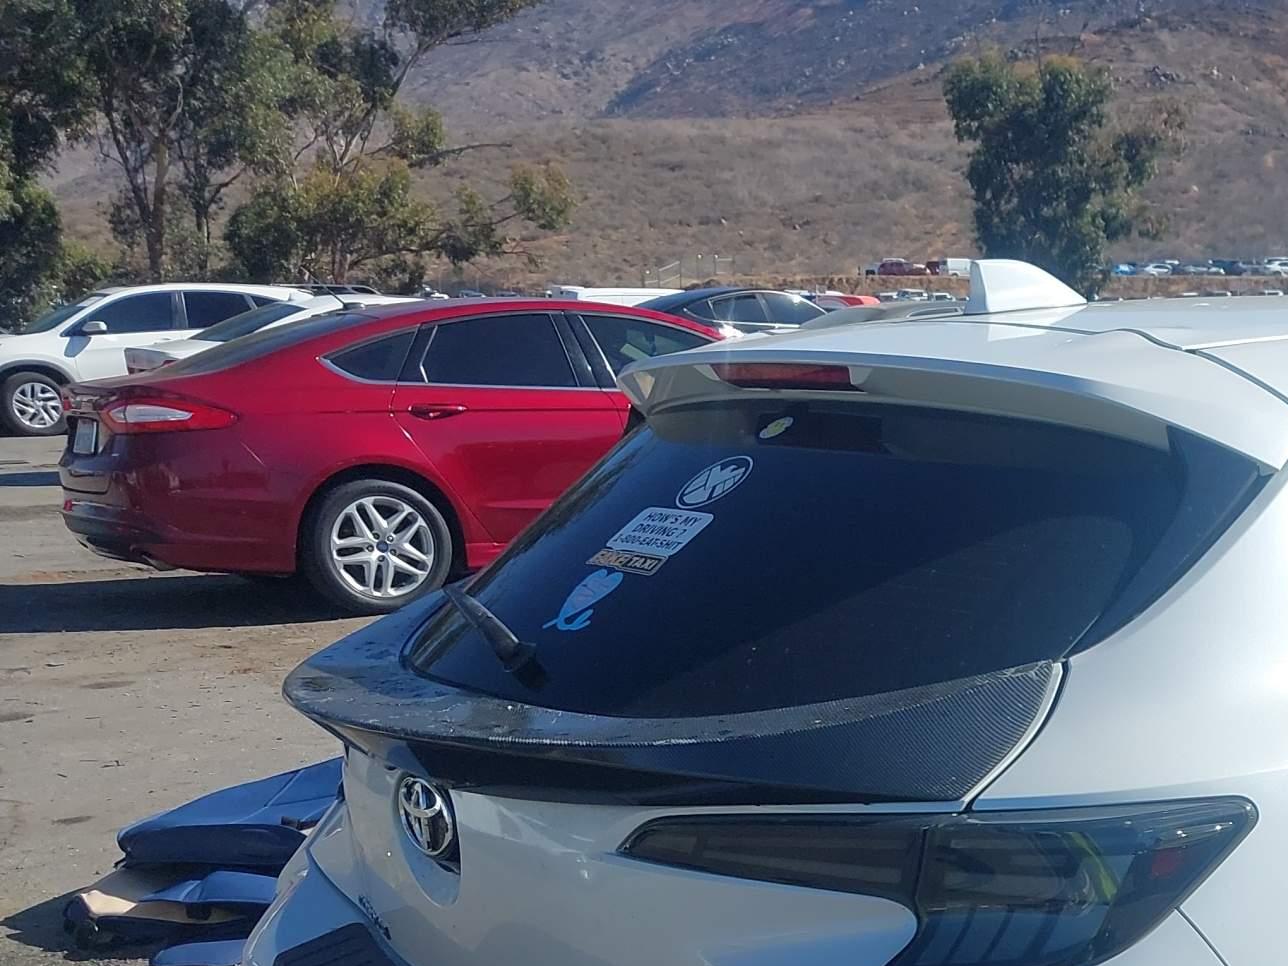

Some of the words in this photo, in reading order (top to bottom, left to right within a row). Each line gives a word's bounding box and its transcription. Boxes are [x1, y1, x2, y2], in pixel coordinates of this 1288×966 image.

[644, 512, 682, 523] HOW'S
[679, 516, 702, 527] MY
[627, 556, 659, 570] TAXI
